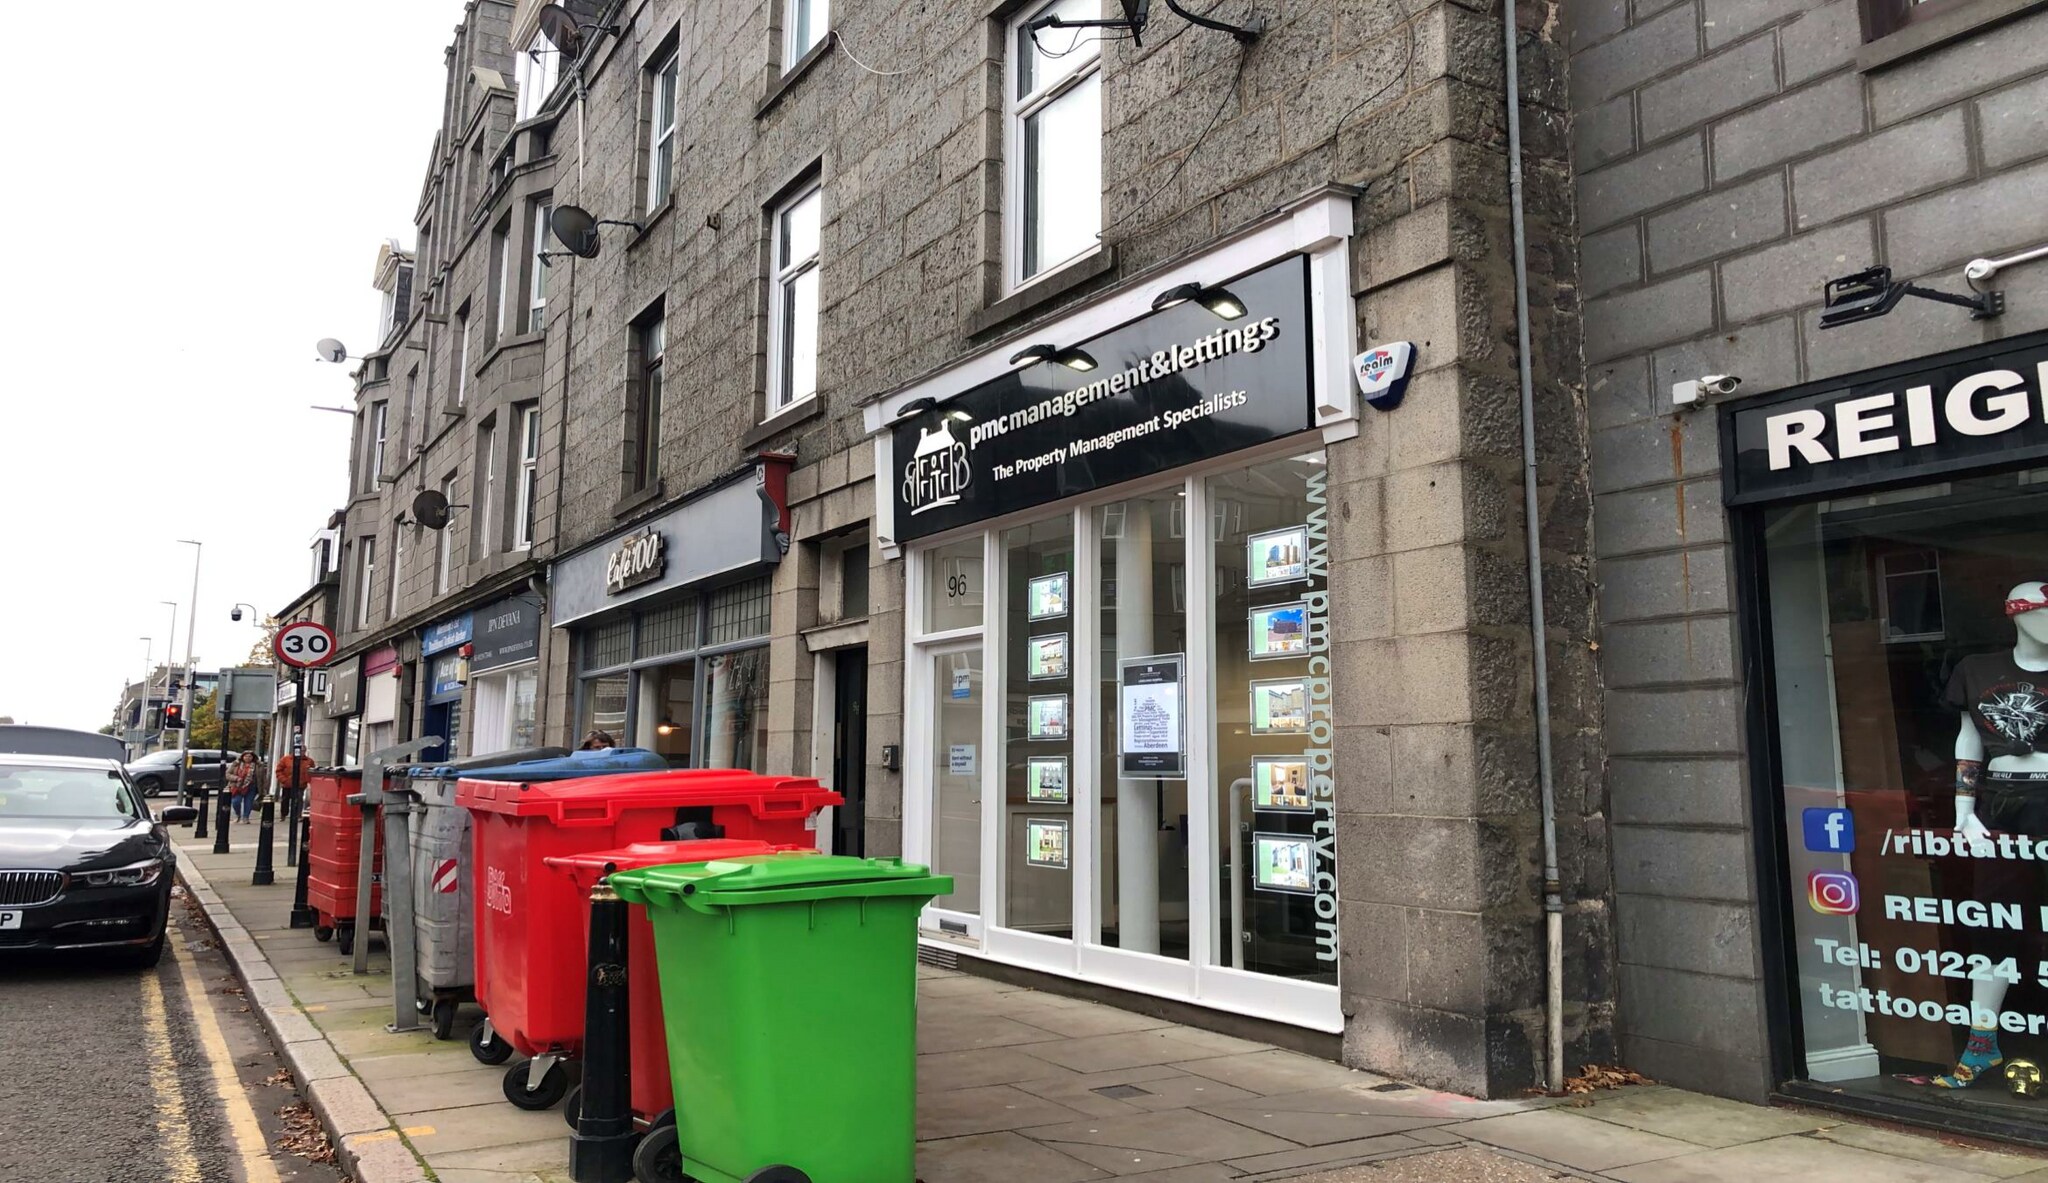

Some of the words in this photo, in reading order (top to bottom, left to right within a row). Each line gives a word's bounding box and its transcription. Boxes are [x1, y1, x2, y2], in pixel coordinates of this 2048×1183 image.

[1360, 356, 1393, 373] realm
[993, 465, 1013, 482] The
[1016, 447, 1067, 475] Property
[1070, 416, 1161, 458] Management
[1163, 389, 1247, 429] Specialists
[1766, 361, 2048, 471] REIG
[948, 573, 967, 598] 96
[285, 635, 328, 653] 30
[1300, 470, 1338, 962] www.pmcproperty.com
[1884, 894, 2023, 930] REIGN
[1814, 938, 1881, 969] Tel:
[1895, 947, 2021, 984] 01224
[1818, 982, 2048, 1035] tattooaber
